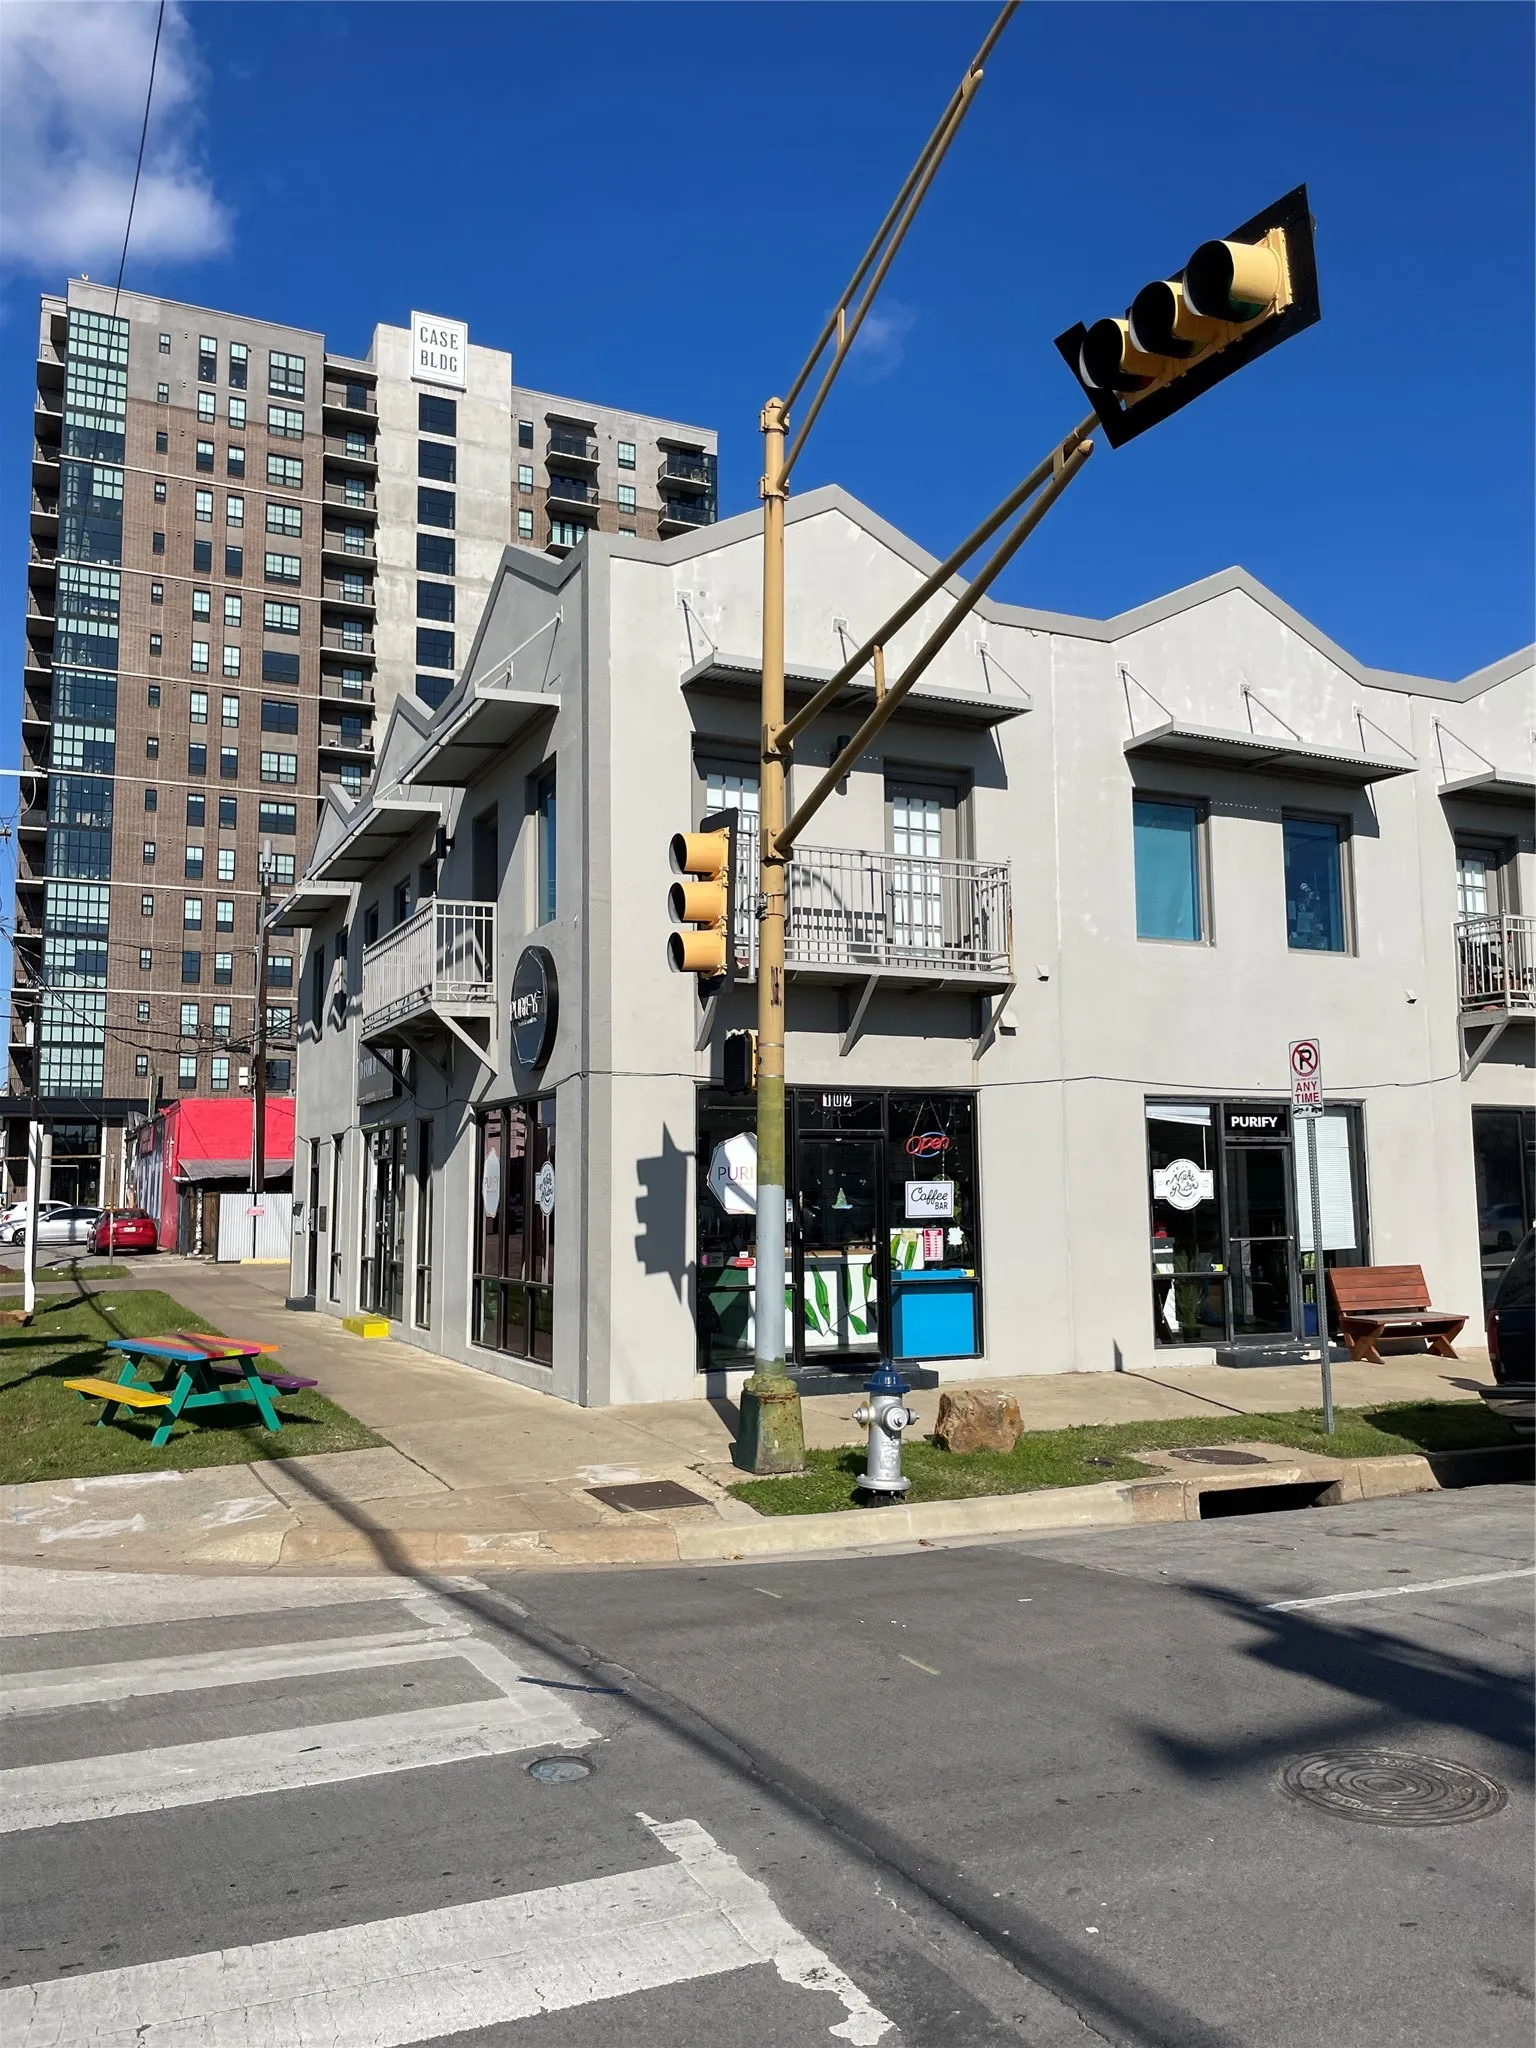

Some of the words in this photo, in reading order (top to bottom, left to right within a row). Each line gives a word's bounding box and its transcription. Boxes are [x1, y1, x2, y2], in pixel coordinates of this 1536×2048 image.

[420, 326, 459, 350] CASE
[421, 349, 457, 373] BLDG
[1295, 1081, 1317, 1093] ANY
[823, 1092, 852, 1107] 102
[1294, 1092, 1320, 1104] TIME
[1230, 1115, 1278, 1128] PURIFY
[905, 1135, 950, 1155] Open
[910, 1186, 949, 1205] Coffee
[934, 1201, 949, 1210] BAR
